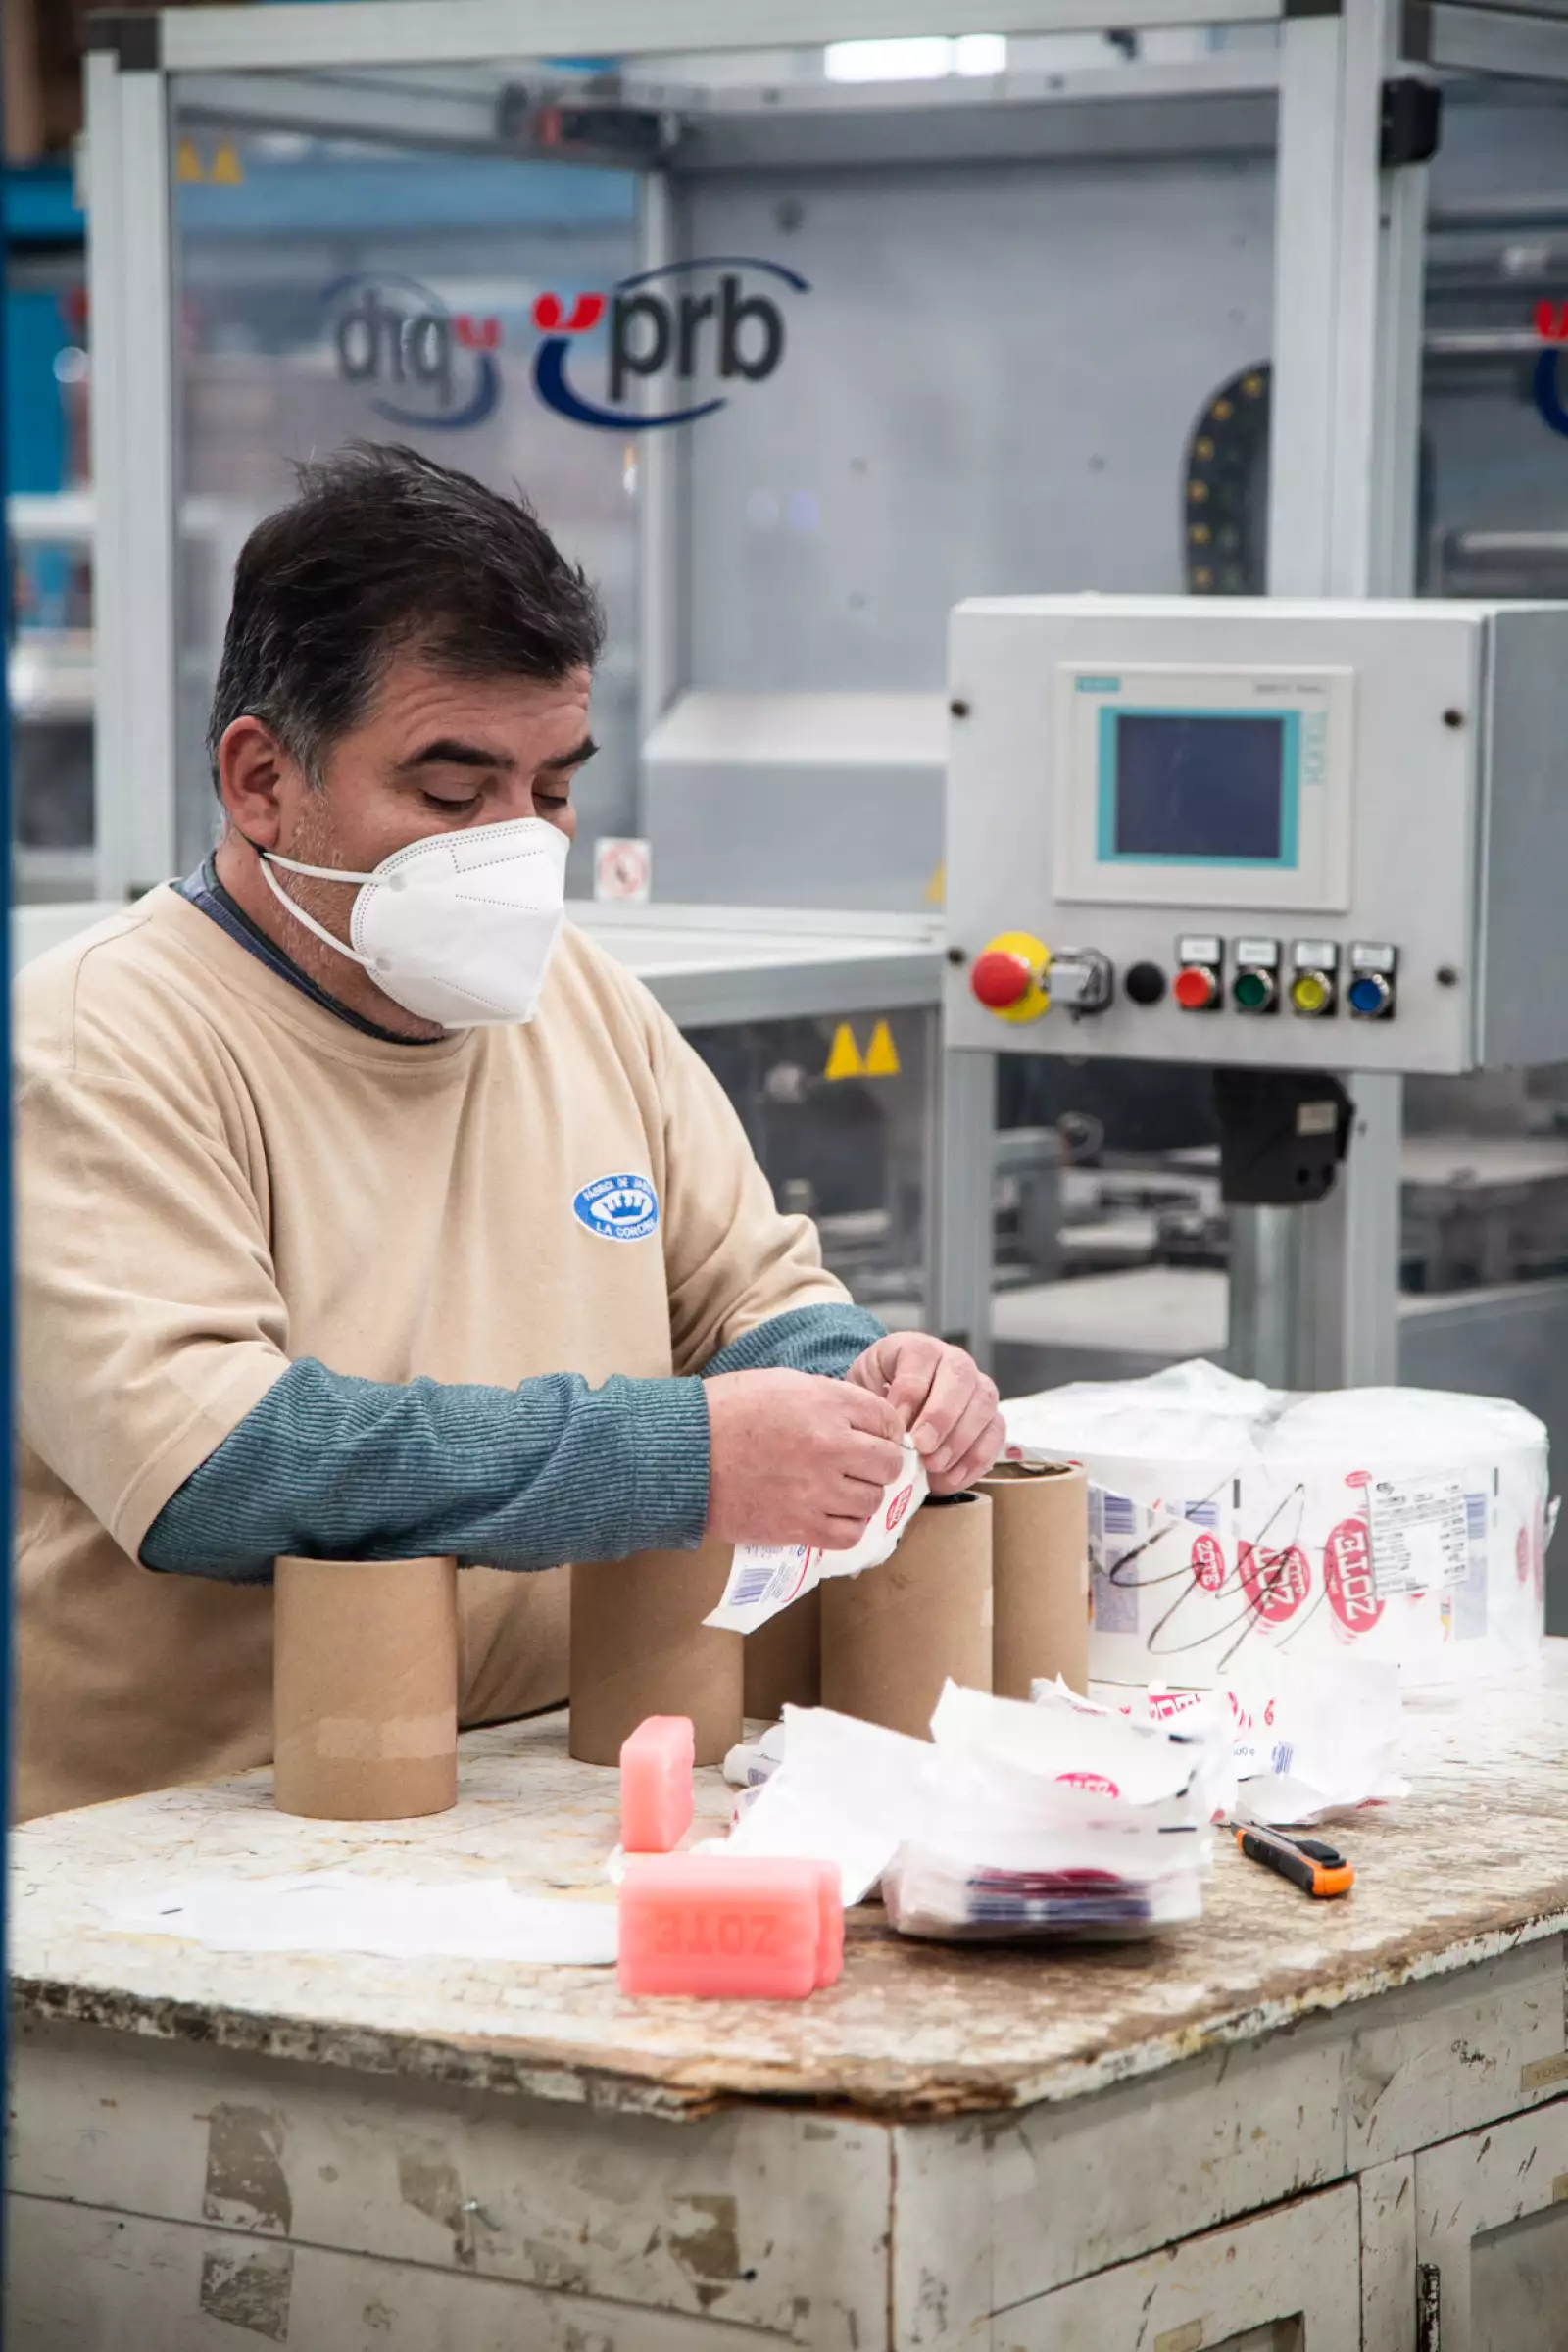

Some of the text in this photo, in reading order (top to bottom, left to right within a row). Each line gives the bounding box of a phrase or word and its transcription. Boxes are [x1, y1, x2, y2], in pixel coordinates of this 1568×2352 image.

[610, 275, 786, 404] prb
[596, 1220, 612, 1236] LA
[1195, 1539, 1222, 1586] ZOTE
[1335, 1531, 1378, 1621] ZOTE
[654, 1913, 780, 1957] ZOTE
